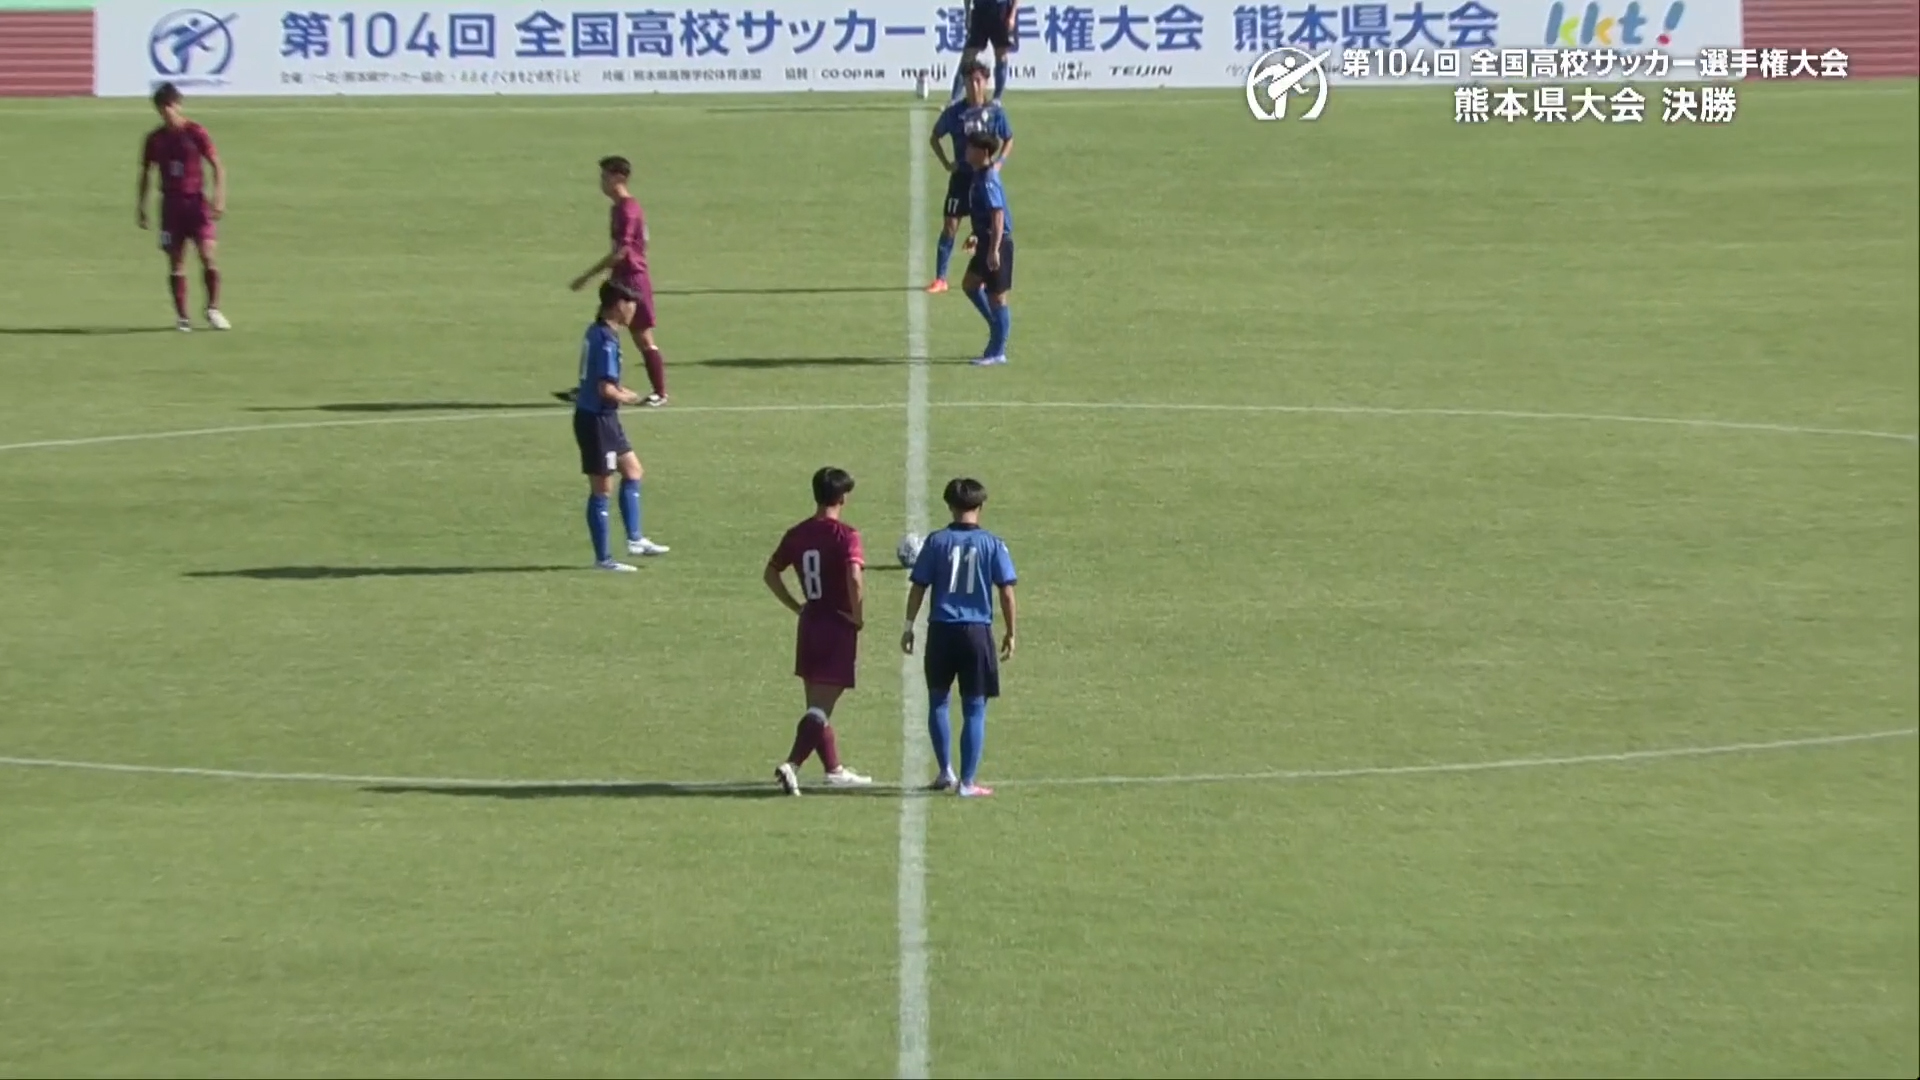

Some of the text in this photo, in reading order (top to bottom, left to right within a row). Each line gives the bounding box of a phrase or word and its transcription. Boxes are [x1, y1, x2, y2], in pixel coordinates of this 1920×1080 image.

[281, 11, 497, 59] 第104回
[1234, 2, 1499, 52] 熊本県大会
[1110, 64, 1174, 78] TEIJIN
[802, 549, 822, 600] 8
[949, 545, 978, 595] 11
